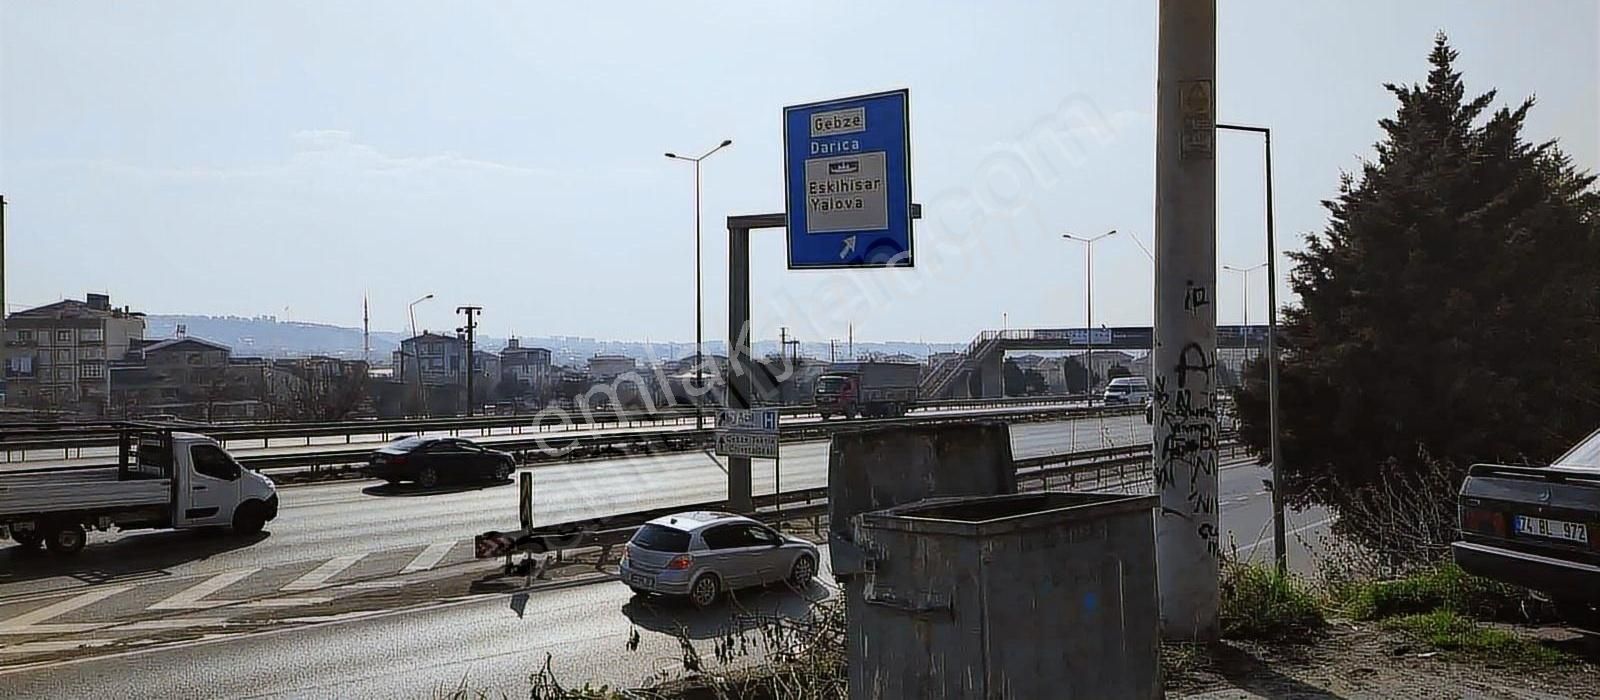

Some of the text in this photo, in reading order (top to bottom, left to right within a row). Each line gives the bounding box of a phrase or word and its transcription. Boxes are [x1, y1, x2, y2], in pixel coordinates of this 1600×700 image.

[814, 115, 861, 131] Gebze
[809, 179, 881, 195] Eskihisar
[811, 196, 863, 211] Yalova
[1520, 517, 1586, 540] 74 BL 972
